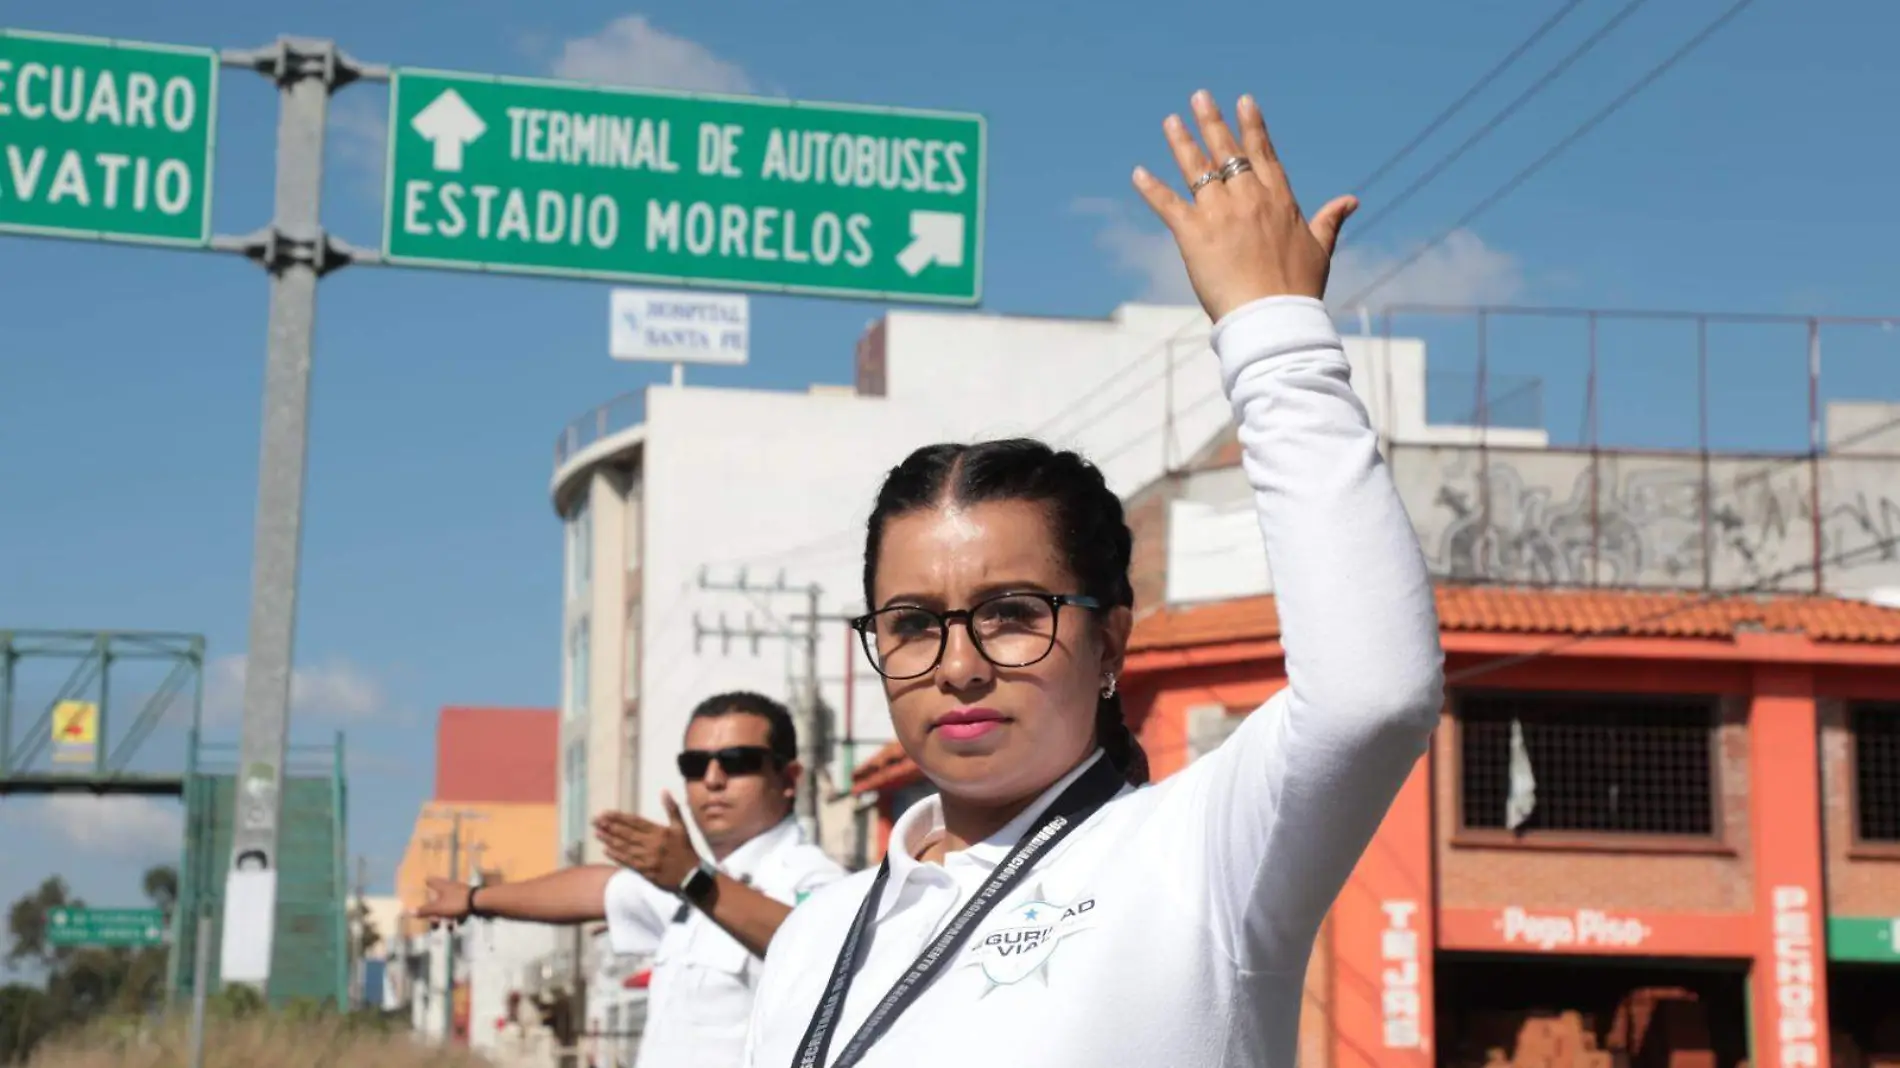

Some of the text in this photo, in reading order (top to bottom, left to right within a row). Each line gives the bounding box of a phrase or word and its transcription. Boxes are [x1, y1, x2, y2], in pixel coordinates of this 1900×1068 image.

[0, 143, 192, 215] VATIO
[506, 106, 967, 194] TERMINAL DE AUTOBUSES
[404, 179, 873, 267] ESTADIO MORELOS
